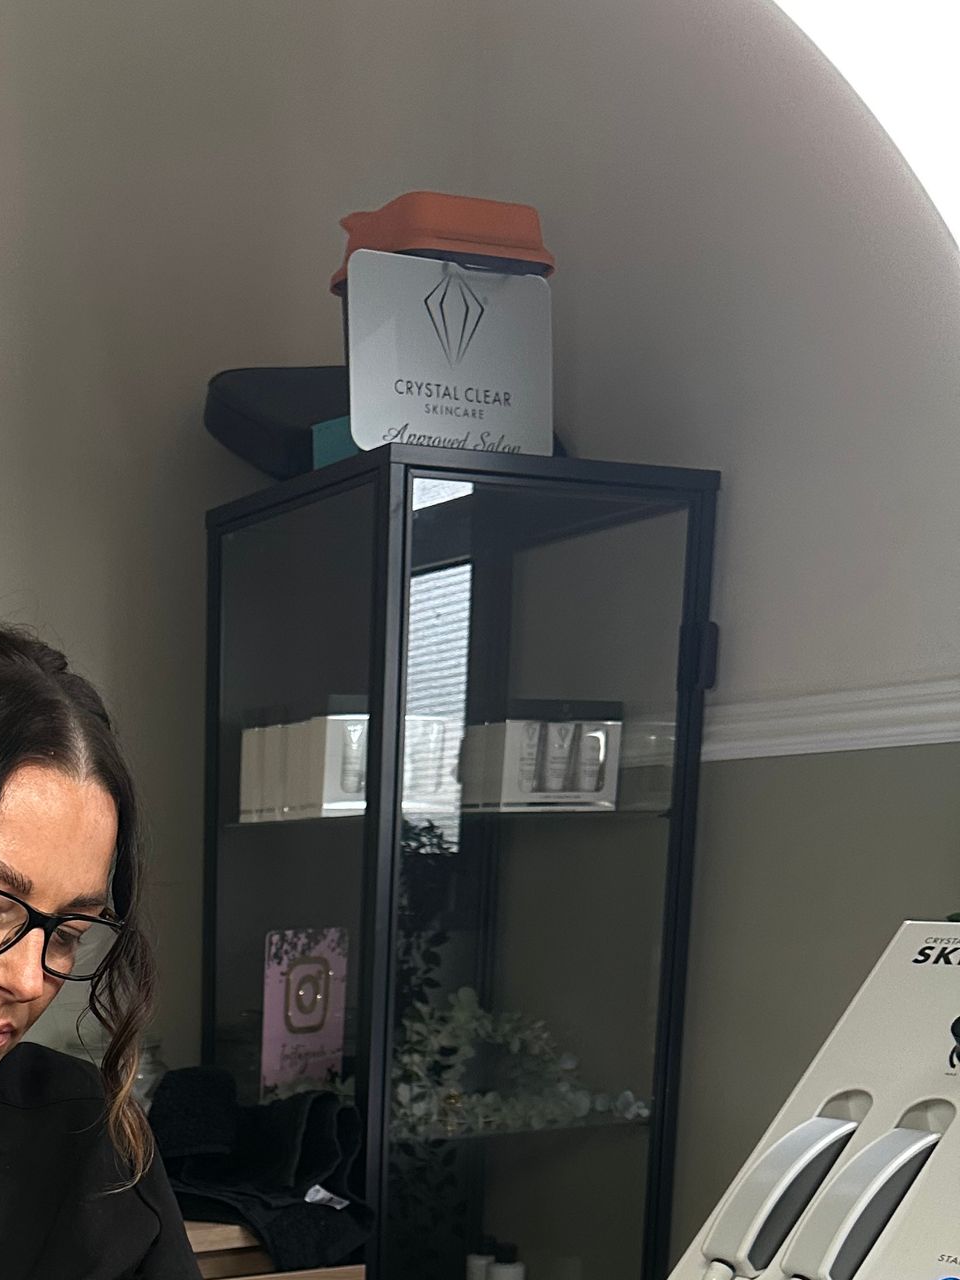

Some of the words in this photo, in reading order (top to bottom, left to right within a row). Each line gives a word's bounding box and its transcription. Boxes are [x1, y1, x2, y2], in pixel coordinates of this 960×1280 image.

[394, 379, 459, 401] CRYSTAL
[464, 387, 512, 407] CLEAR
[424, 403, 484, 419] SKINCARE
[912, 945, 960, 965] SK
[938, 1254, 960, 1265] STA
